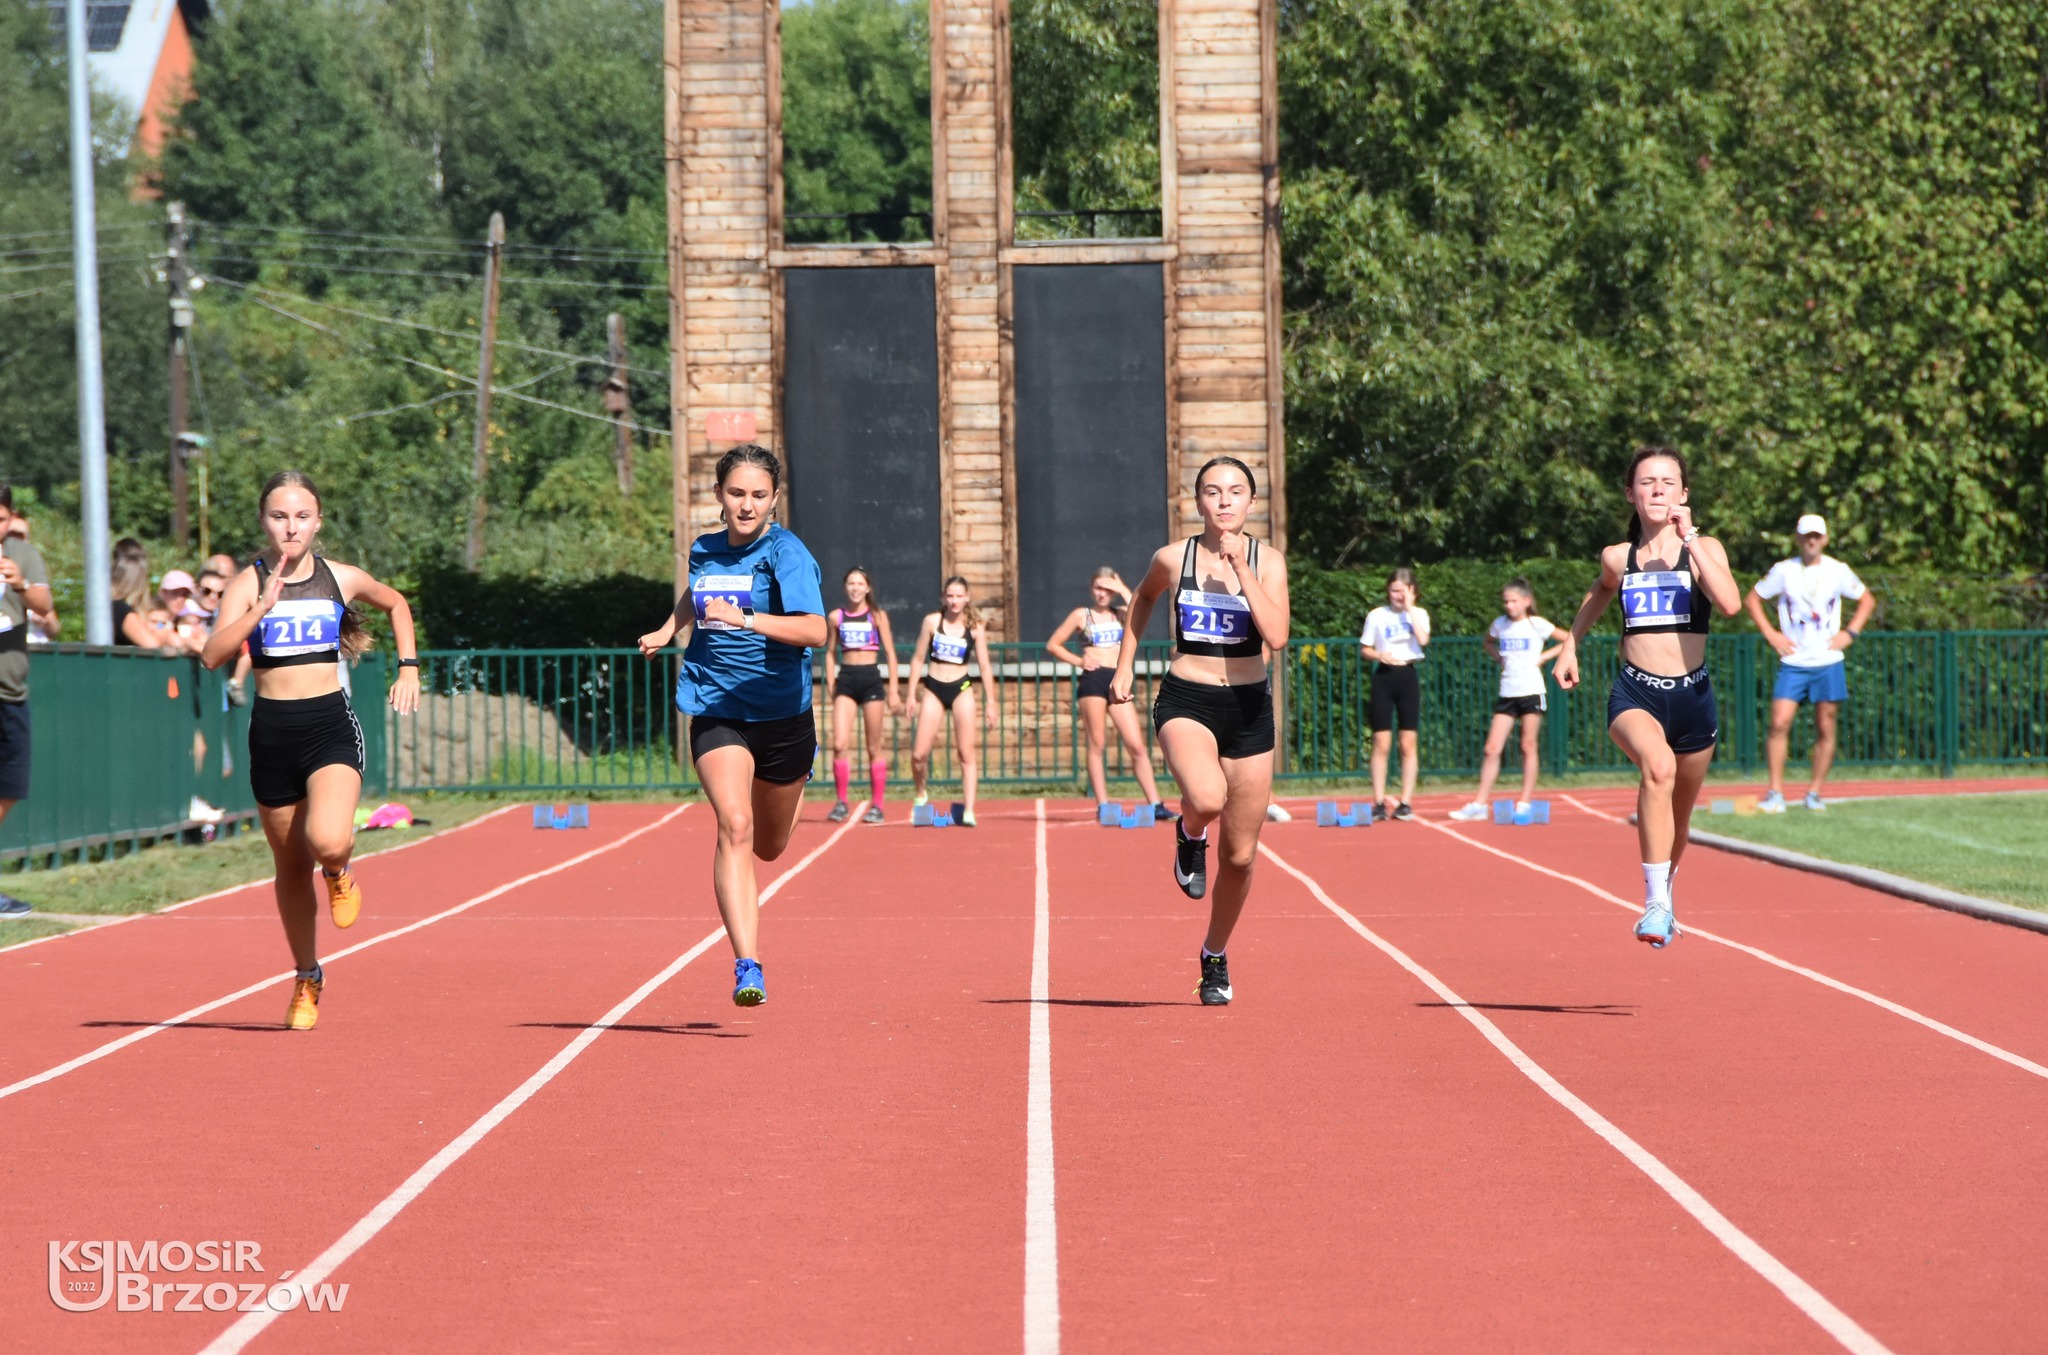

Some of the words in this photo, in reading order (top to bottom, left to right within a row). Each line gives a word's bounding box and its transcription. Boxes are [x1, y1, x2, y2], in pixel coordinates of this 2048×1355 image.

[1633, 590, 1676, 613] 217
[274, 619, 323, 643] 214
[1190, 610, 1234, 633] 215
[844, 631, 866, 643] 254
[937, 643, 959, 656] 224
[1636, 672, 1676, 690] PRO
